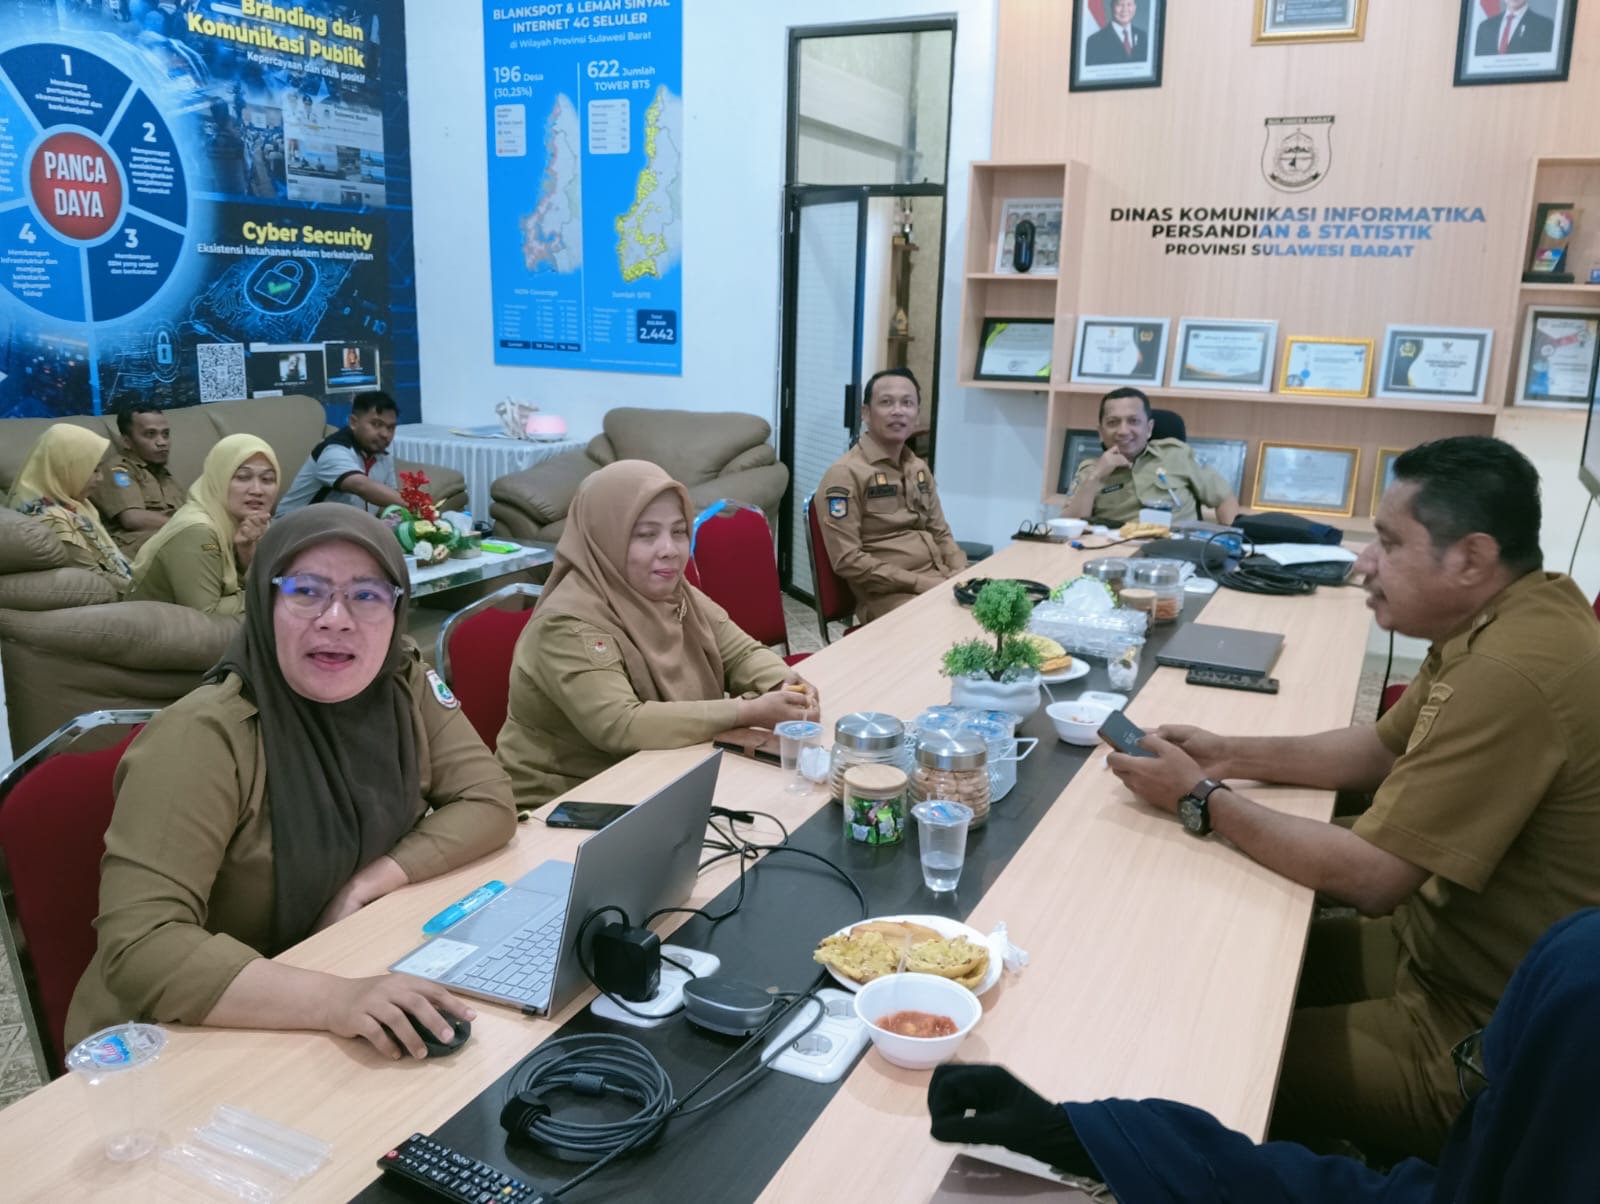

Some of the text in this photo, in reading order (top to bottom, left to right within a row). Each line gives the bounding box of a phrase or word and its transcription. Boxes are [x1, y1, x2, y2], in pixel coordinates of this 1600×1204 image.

[492, 3, 563, 20] BLANKSPOT
[566, 2, 574, 14] &
[577, 0, 622, 13] LEMAH
[241, 0, 364, 42] Branding dan
[513, 12, 648, 33] INTERNET 4G SELULER
[187, 12, 366, 68] Komunikasi Publik
[510, 31, 652, 49] di Wilayah Provinsi Sulawesi Barat
[60, 53, 72, 76] 1
[247, 51, 303, 71] Kepercayaan
[304, 61, 321, 74] dan
[587, 60, 656, 78] 622 Jumlah
[493, 66, 544, 84] 196 Desa
[594, 79, 650, 92] TOWER BTS
[142, 121, 157, 143] 2
[44, 151, 108, 184] PANCA
[54, 188, 104, 218] DAYA
[1110, 206, 1486, 223] DINAS KOMUNIKASI INFORMATIKA
[18, 223, 36, 244] 4
[124, 228, 139, 249] 3
[242, 221, 373, 250] Cyber Security
[1152, 224, 1432, 240] PERSANDIAN & STATISTIK
[197, 243, 374, 261] Eksistensi ketahanan sistem berkelanjutan
[1165, 243, 1415, 258] PROVINSI SULAWESI BARAT
[639, 327, 674, 341] 2.442
